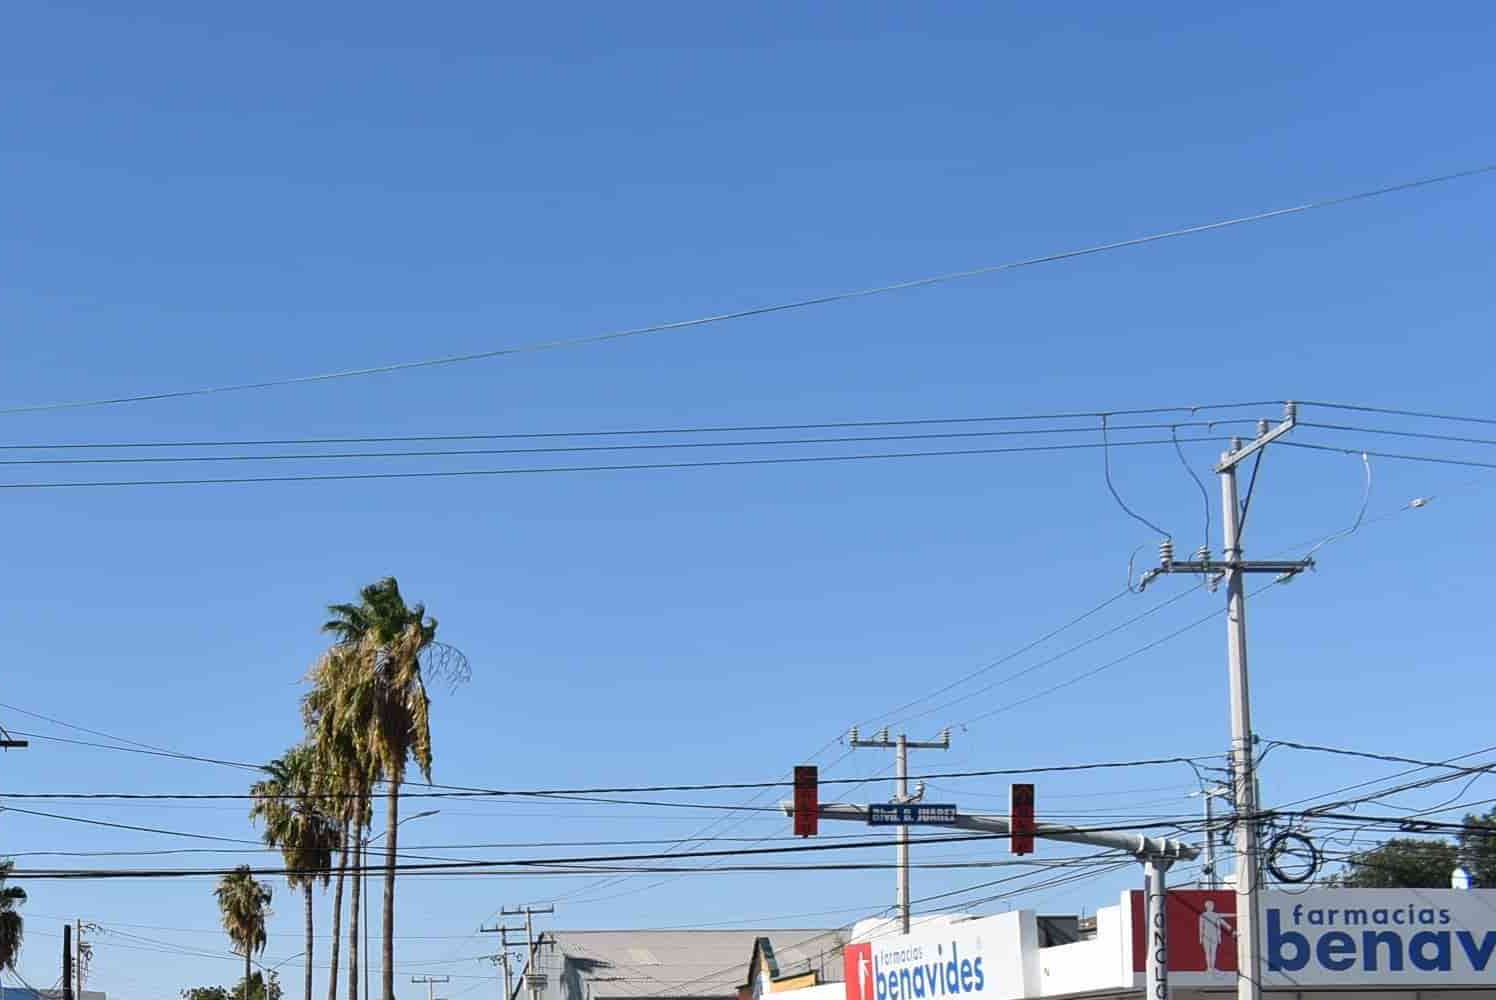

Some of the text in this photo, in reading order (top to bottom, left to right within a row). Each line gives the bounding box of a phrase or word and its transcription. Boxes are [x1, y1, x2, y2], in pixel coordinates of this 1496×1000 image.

[1292, 903, 1452, 926] farmacias
[1266, 908, 1496, 972] benav
[880, 945, 923, 967] farmacias
